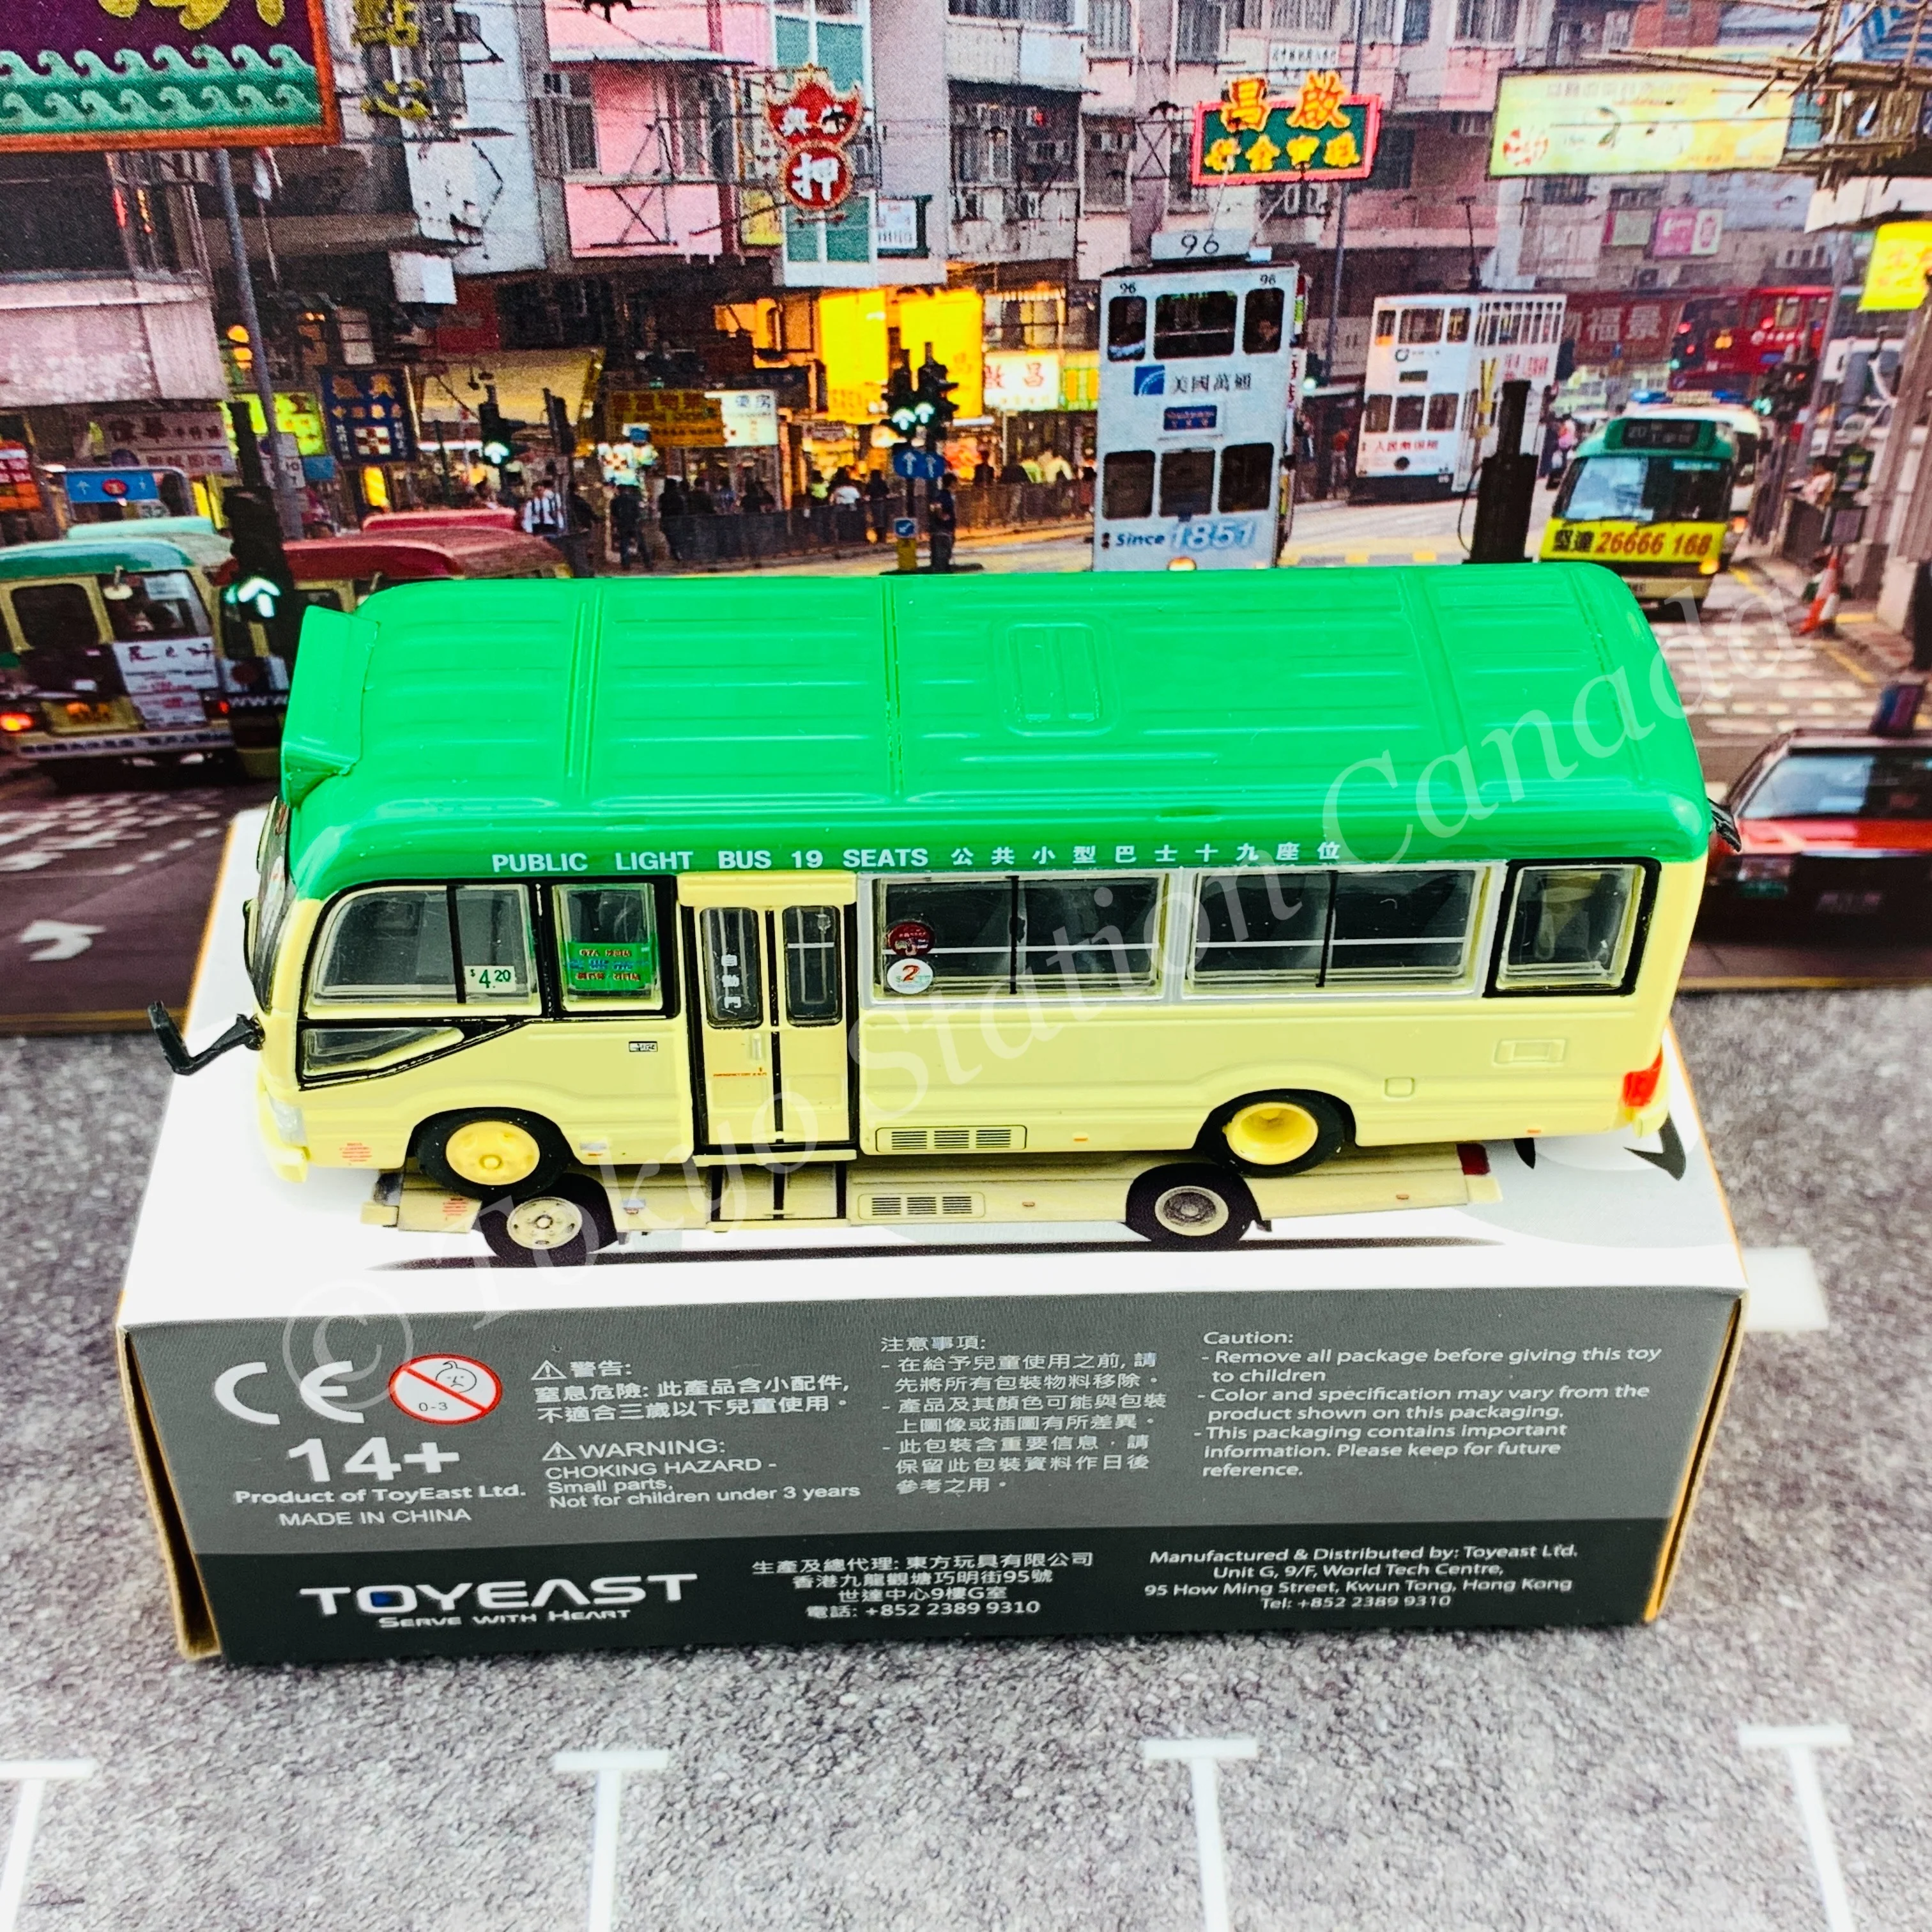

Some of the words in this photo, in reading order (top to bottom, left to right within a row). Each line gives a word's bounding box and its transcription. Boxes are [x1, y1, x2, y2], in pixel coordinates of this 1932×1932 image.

[792, 153, 840, 201] 押
[1180, 233, 1220, 256] 96
[1119, 282, 1137, 295] 96
[1260, 273, 1276, 286] 96
[1116, 533, 1164, 546] Since
[1172, 519, 1254, 549] 1851
[1595, 531, 1665, 555] 26666
[492, 853, 588, 873] PUBLIC
[616, 851, 693, 870] LIGHT
[718, 850, 770, 869] BUS
[791, 850, 823, 869] 19
[843, 848, 928, 867] SEATS
[903, 965, 920, 982] 2
[1203, 1331, 1293, 1345] Caution:
[1215, 1350, 1301, 1363] Remove
[1307, 1349, 1332, 1363] all
[1337, 1348, 1429, 1366] package
[1433, 1347, 1504, 1362] before
[1508, 1348, 1577, 1365] giving
[1582, 1347, 1621, 1361] this
[1627, 1348, 1662, 1363] toy
[569, 1360, 632, 1378] 警告:
[1211, 1371, 1235, 1383] to
[1239, 1368, 1326, 1383] children
[1210, 1388, 1268, 1402] Color
[1271, 1387, 1313, 1401] and
[1317, 1386, 1452, 1404] specification
[1457, 1389, 1503, 1403] may
[1508, 1389, 1554, 1402] vary
[1559, 1385, 1609, 1399] from
[1614, 1384, 1650, 1398] the
[419, 1402, 448, 1411] 0-3
[1208, 1406, 1292, 1424] product
[1296, 1406, 1367, 1420] shown
[1372, 1409, 1400, 1420] on
[1406, 1405, 1444, 1420] this
[1449, 1404, 1564, 1422] packaging.
[1206, 1426, 1248, 1439] This
[1253, 1425, 1361, 1443] packaging
[1367, 1424, 1455, 1438] contains
[1461, 1424, 1568, 1440] important
[578, 1438, 725, 1459] WARNING:
[1204, 1444, 1331, 1459] information.
[1337, 1443, 1402, 1457] Please
[1407, 1443, 1459, 1459] keep
[1463, 1441, 1494, 1455] for
[1498, 1441, 1561, 1455] future
[288, 1437, 460, 1483] 14+
[545, 1462, 657, 1480] CHOKING
[664, 1458, 762, 1474] HAZARD
[1202, 1462, 1303, 1477] reference.
[233, 1491, 335, 1504] Product
[340, 1489, 367, 1503] of
[371, 1487, 473, 1505] ToyEast
[479, 1483, 526, 1498] Ltd.
[548, 1482, 607, 1494] Small
[550, 1496, 588, 1508] Not
[594, 1493, 622, 1506] for
[627, 1491, 710, 1505] children
[717, 1488, 777, 1502] under
[784, 1486, 796, 1499] 3
[803, 1485, 861, 1500] years
[279, 1511, 353, 1526] MADE
[360, 1511, 385, 1524] IN
[392, 1508, 472, 1524] CHINA
[1149, 1548, 1289, 1563] Manufactured
[1293, 1549, 1308, 1561] &
[1313, 1546, 1424, 1561] Distributed
[1429, 1545, 1459, 1561] by:
[1463, 1545, 1537, 1561] Toyeast
[1542, 1544, 1577, 1558] Ltd.
[1213, 1566, 1255, 1579] Unit
[1259, 1565, 1279, 1579] G,
[1284, 1565, 1318, 1578] 9/F,
[1322, 1563, 1381, 1577] World
[1386, 1563, 1430, 1576] Tech
[1435, 1563, 1503, 1576] Centre,
[300, 1574, 698, 1617] TOYEAST
[1144, 1584, 1169, 1596] 95
[1173, 1584, 1218, 1596] How
[1223, 1583, 1273, 1597] Ming
[1278, 1581, 1340, 1594] Street,
[1346, 1581, 1400, 1593] Kwun
[1405, 1579, 1457, 1593] Tong,
[1462, 1579, 1516, 1592] Hong
[1521, 1577, 1573, 1592] Kong
[864, 1604, 919, 1616] +852
[927, 1602, 979, 1615] 2389
[986, 1600, 1039, 1613] 9310
[1261, 1597, 1292, 1609] Tel:
[1298, 1597, 1346, 1609] +852
[1351, 1595, 1399, 1607] 2389
[1404, 1595, 1452, 1607] 9310
